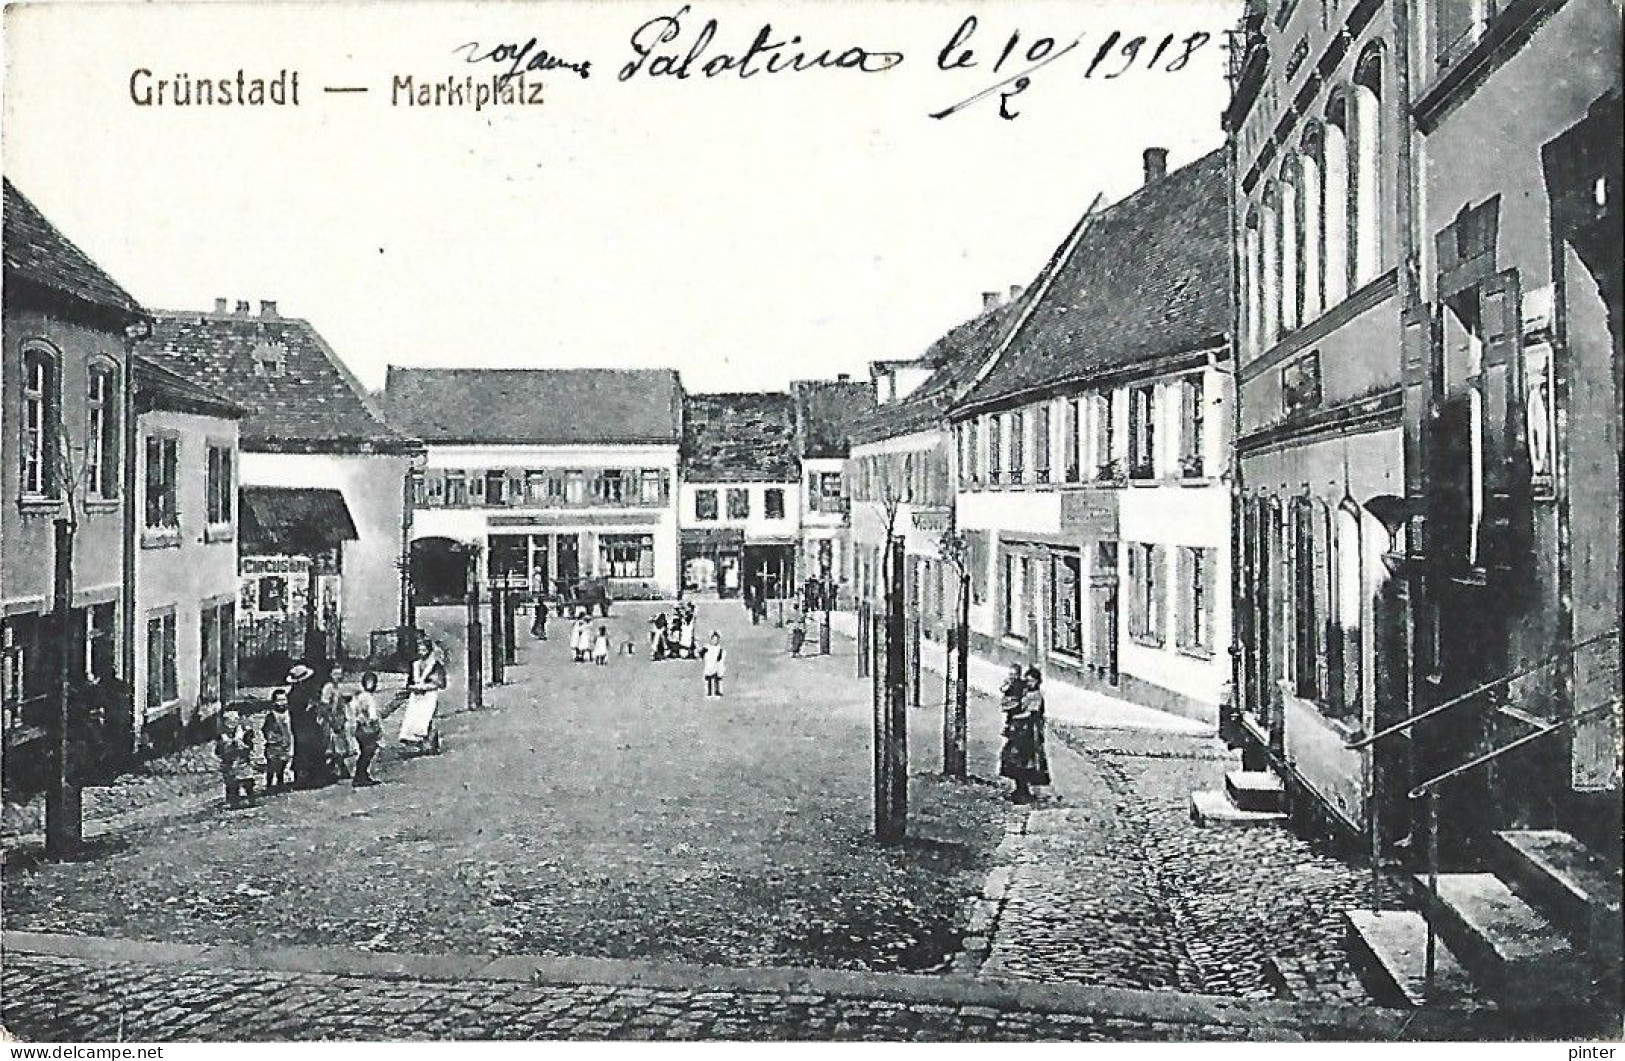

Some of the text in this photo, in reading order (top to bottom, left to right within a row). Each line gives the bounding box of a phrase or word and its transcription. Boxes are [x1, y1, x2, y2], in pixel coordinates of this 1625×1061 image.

[937, 14, 979, 71] le
[1083, 30, 1212, 79] 1918
[129, 68, 299, 106] Grünstadt
[392, 75, 544, 112] Marktplatz
